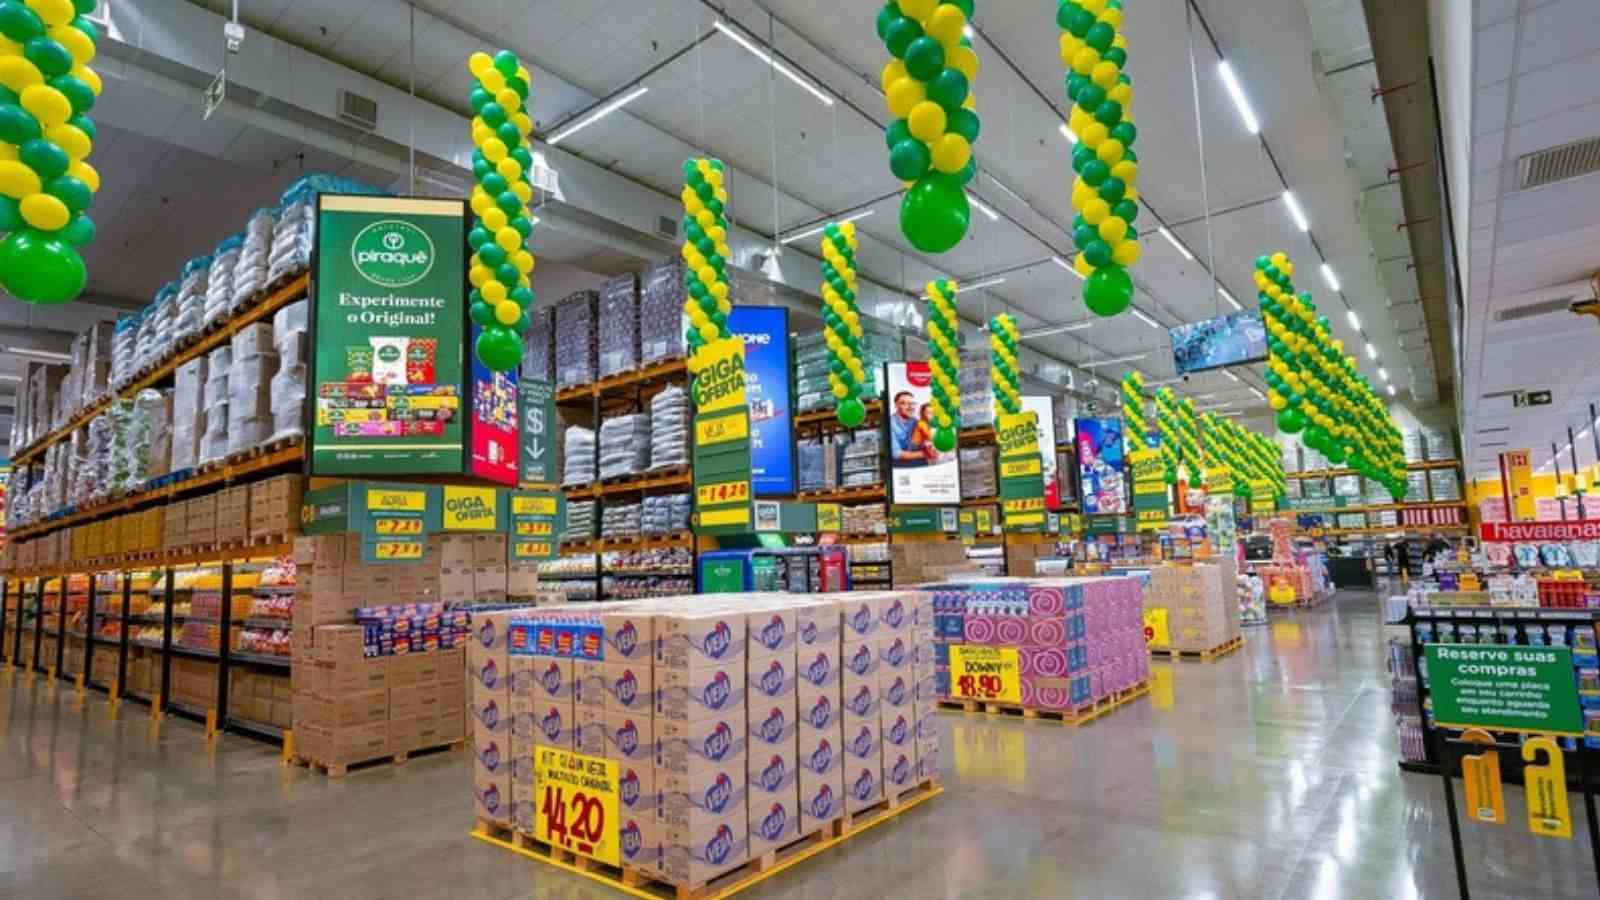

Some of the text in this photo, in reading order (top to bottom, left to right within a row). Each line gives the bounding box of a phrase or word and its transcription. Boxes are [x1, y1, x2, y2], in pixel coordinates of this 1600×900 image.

[358, 249, 428, 267] piraquê
[339, 292, 445, 309] Experimente
[347, 311, 436, 327] o Original!
[700, 353, 745, 387] GIGA
[699, 373, 745, 406] OFERTA
[1000, 421, 1037, 441] GIGA
[446, 496, 485, 511] GIGA
[456, 507, 496, 521] OFERTA
[1494, 521, 1600, 540] havaiana
[1437, 647, 1557, 662] Reserve suas
[965, 661, 1002, 674] DOWNY
[1458, 664, 1537, 677] compras
